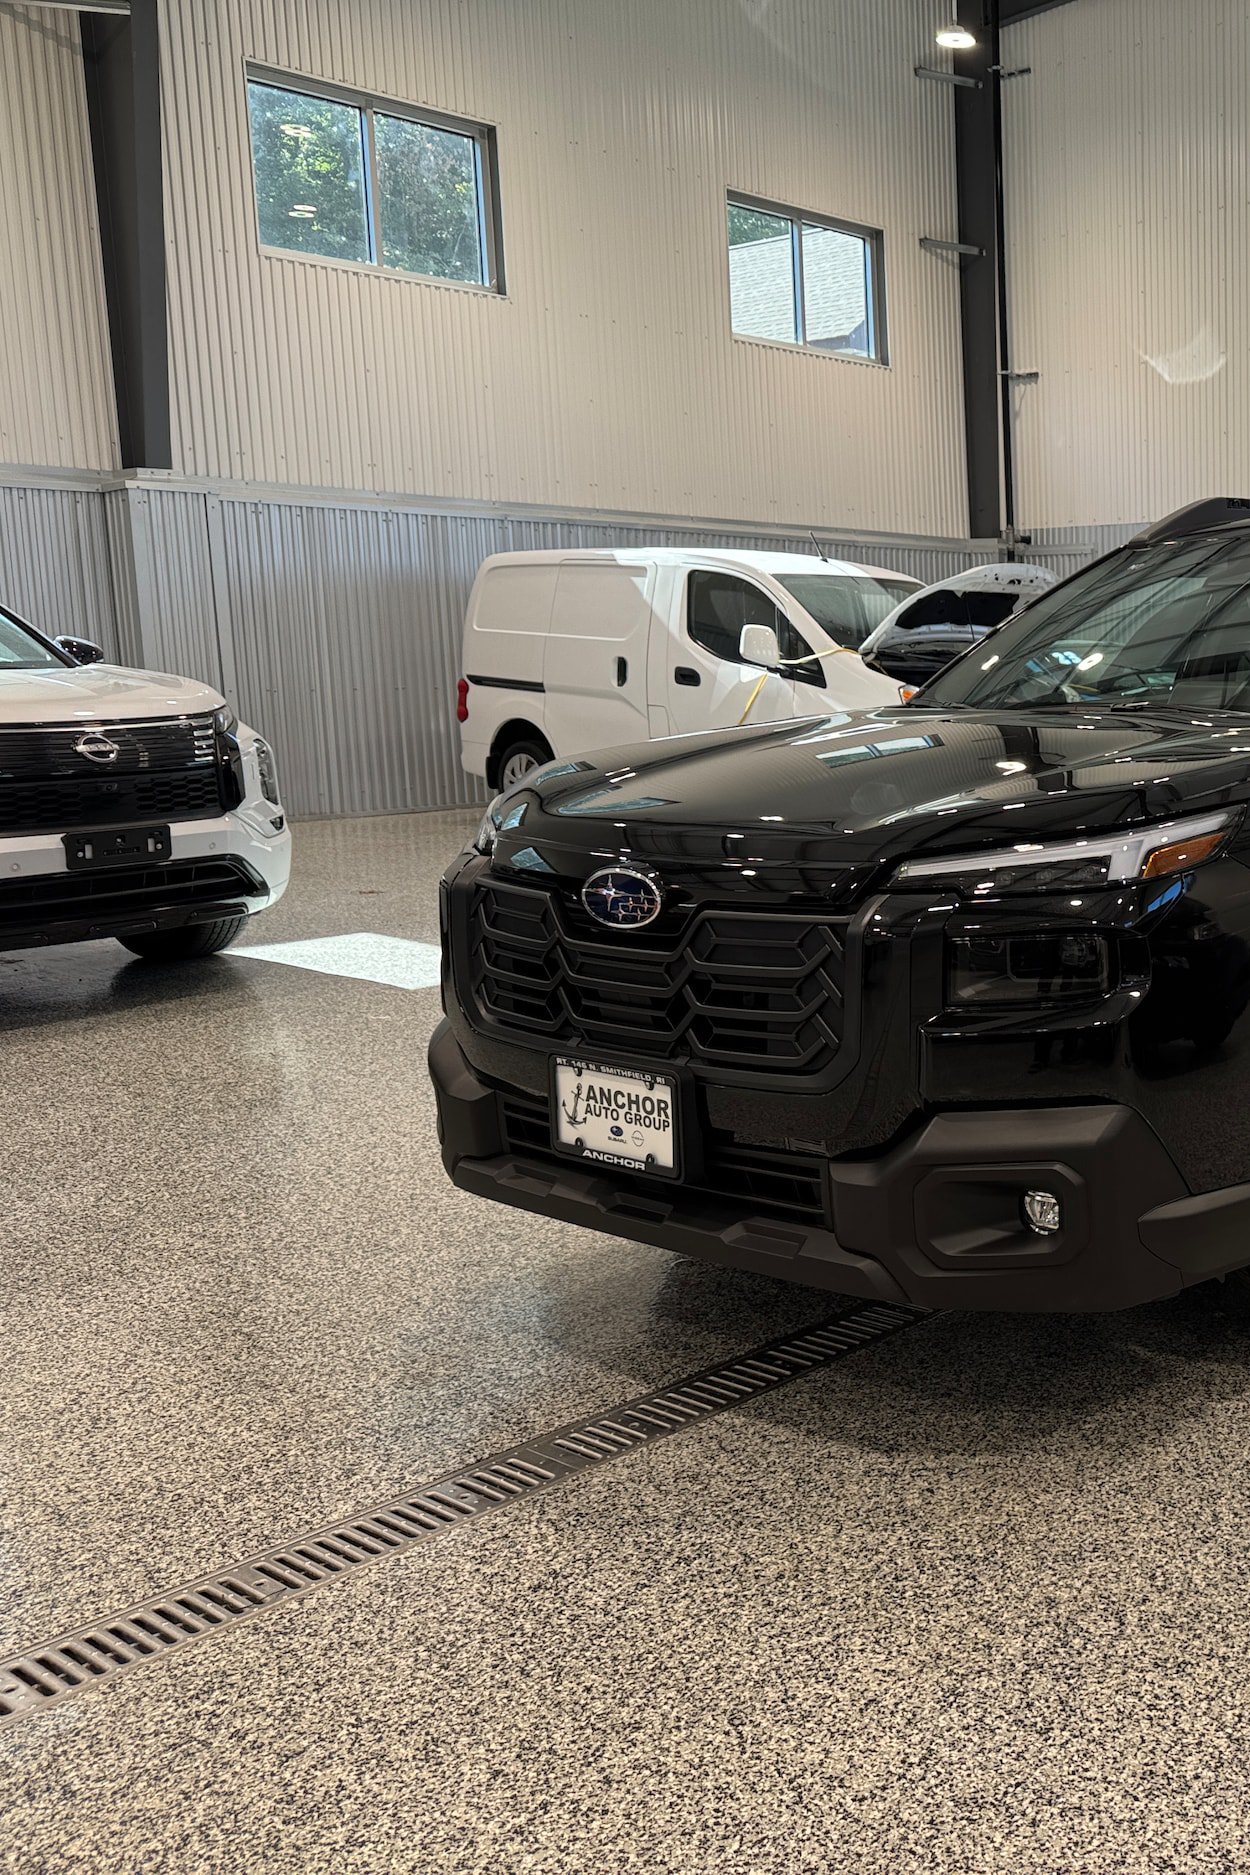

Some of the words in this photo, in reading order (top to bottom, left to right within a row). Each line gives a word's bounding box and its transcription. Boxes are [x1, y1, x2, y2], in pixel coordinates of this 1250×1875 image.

[556, 1057, 569, 1066] RT.
[589, 1063, 599, 1072] N.
[656, 1076, 666, 1085] RI
[585, 1084, 670, 1119] ANCHOR
[584, 1103, 620, 1122] AUTO
[624, 1111, 670, 1132] GROUP
[582, 1149, 646, 1171] ANCHOR
